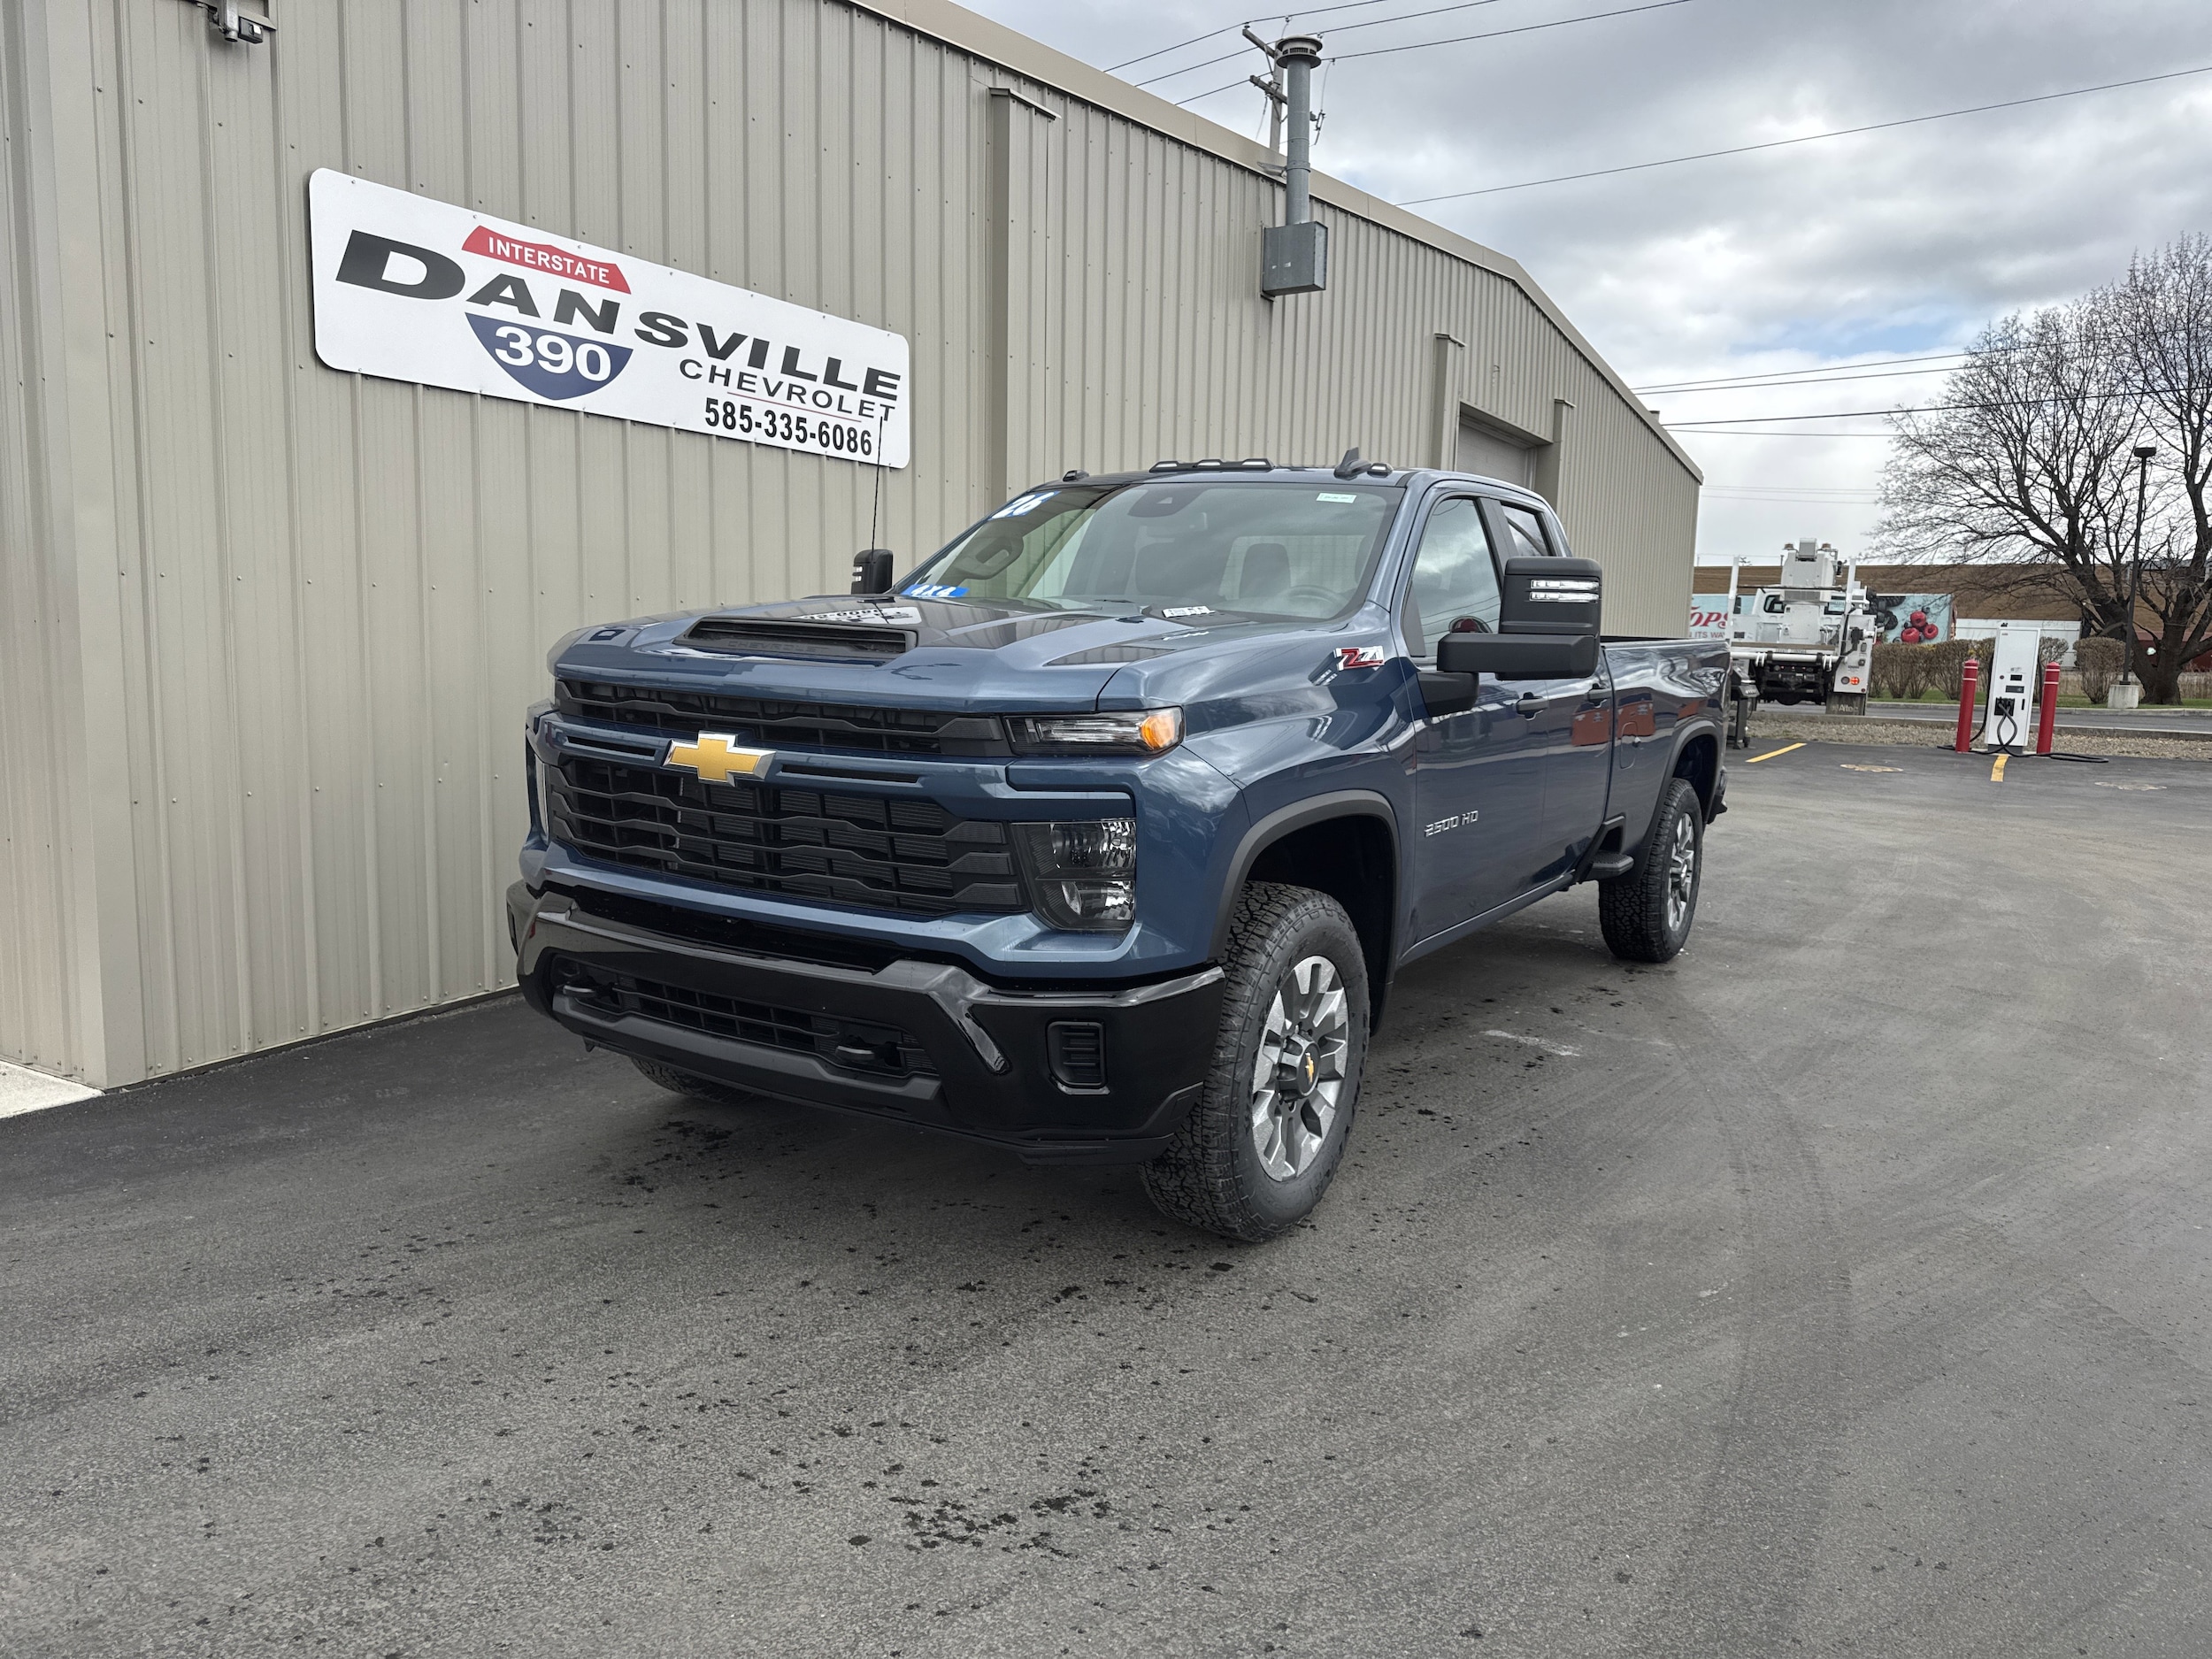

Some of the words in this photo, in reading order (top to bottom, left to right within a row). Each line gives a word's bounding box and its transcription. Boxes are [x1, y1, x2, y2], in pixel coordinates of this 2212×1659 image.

[488, 236, 610, 284] INTERSTATE
[335, 229, 901, 401] DANSVILLE
[495, 326, 611, 381] 390
[680, 359, 895, 421] CHEVROLET
[705, 397, 872, 456] 585-335-6086
[1690, 606, 1728, 629] OPS
[727, 641, 829, 653] CHEVROLET
[1425, 816, 1459, 837] 2500
[1461, 810, 1479, 826] HD
